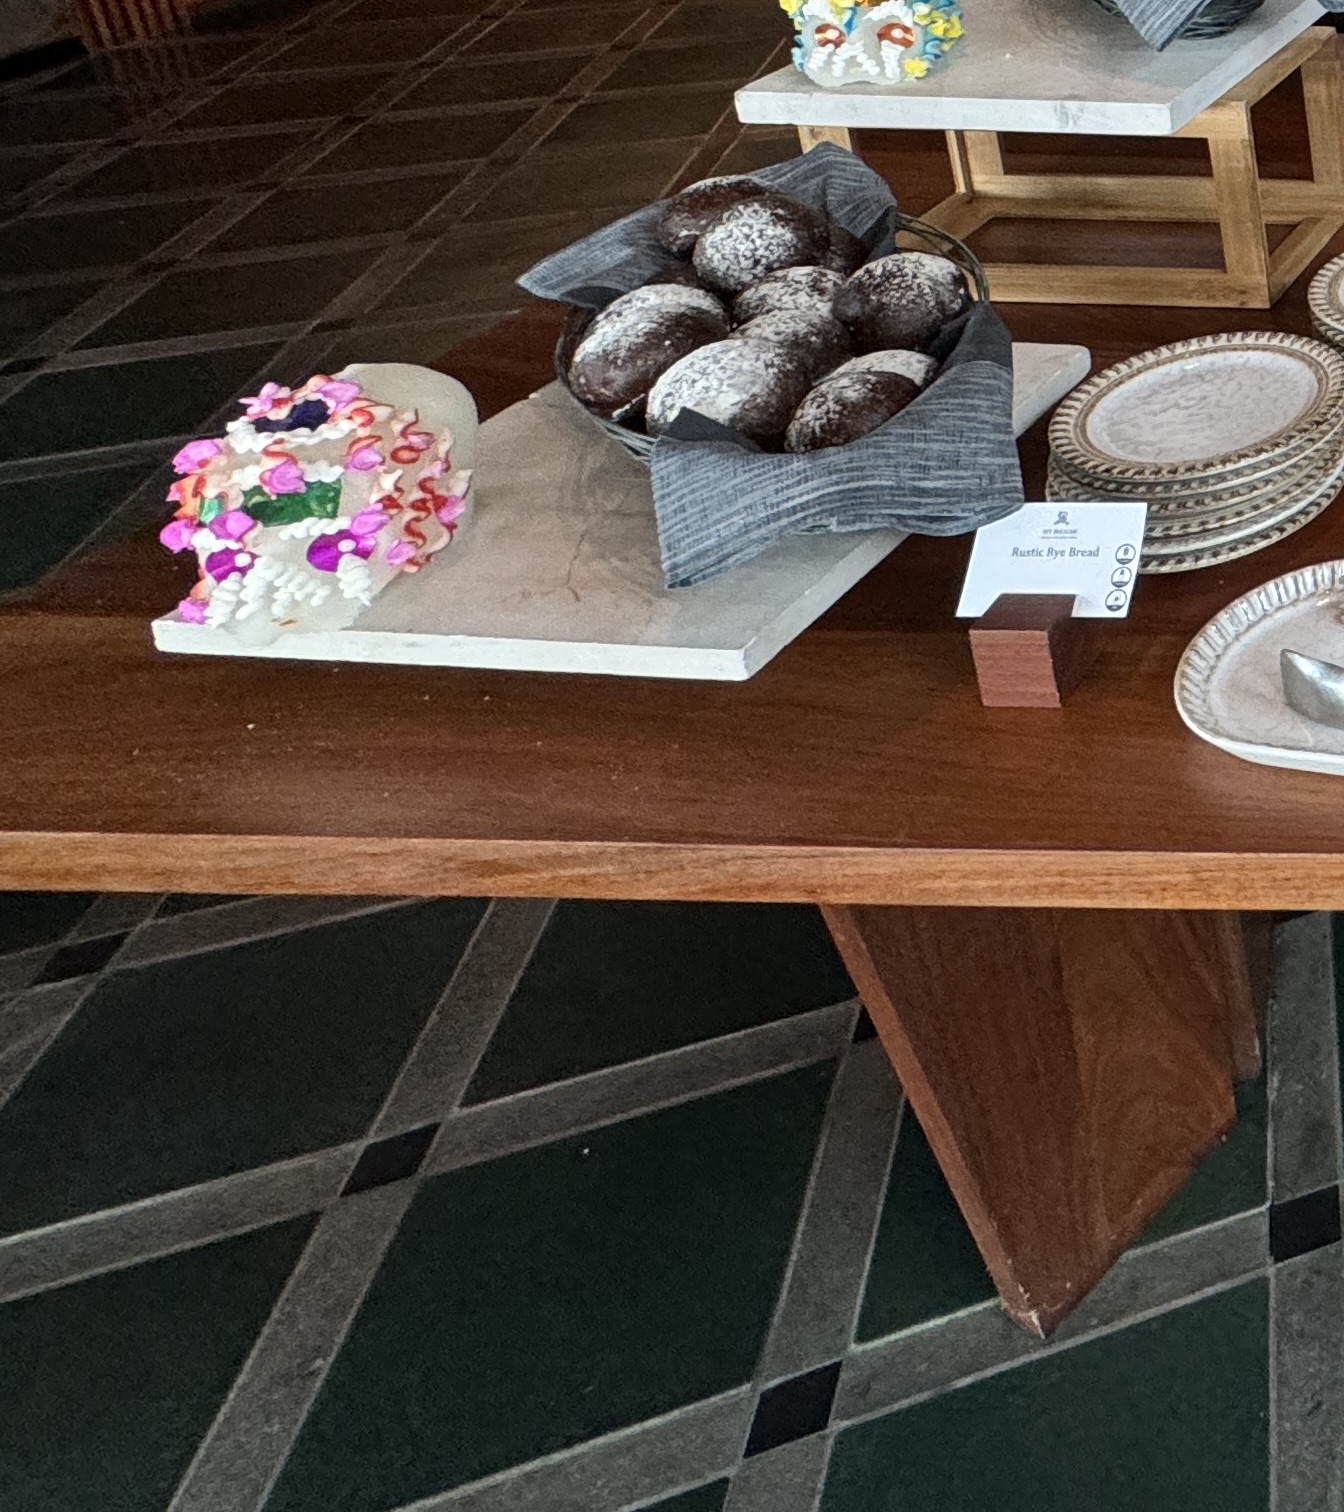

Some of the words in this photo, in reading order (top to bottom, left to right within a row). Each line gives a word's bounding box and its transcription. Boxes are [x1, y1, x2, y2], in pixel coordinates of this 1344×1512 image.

[1011, 546, 1044, 557] Rustic
[1046, 547, 1066, 560] Rye
[1069, 545, 1100, 557] Bread
